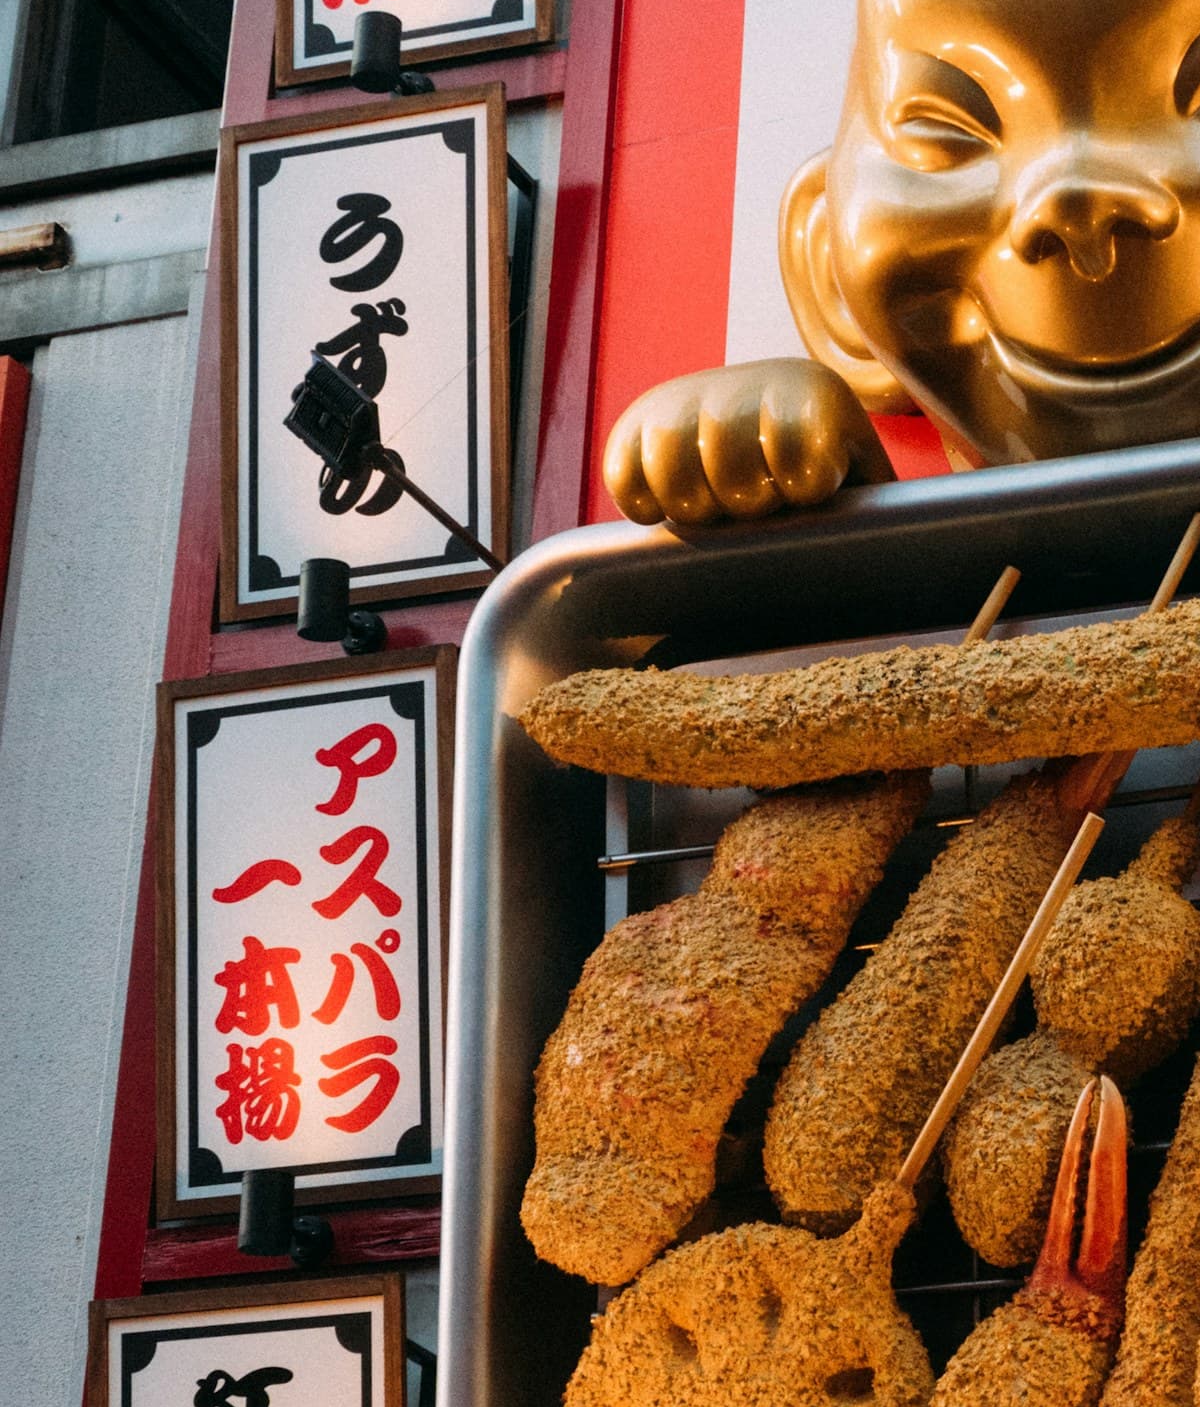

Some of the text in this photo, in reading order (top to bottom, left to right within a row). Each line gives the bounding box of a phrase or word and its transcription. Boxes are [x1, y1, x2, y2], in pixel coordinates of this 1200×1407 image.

[212, 860, 302, 1144] 一本揚
[312, 724, 402, 1133] アスパラ
